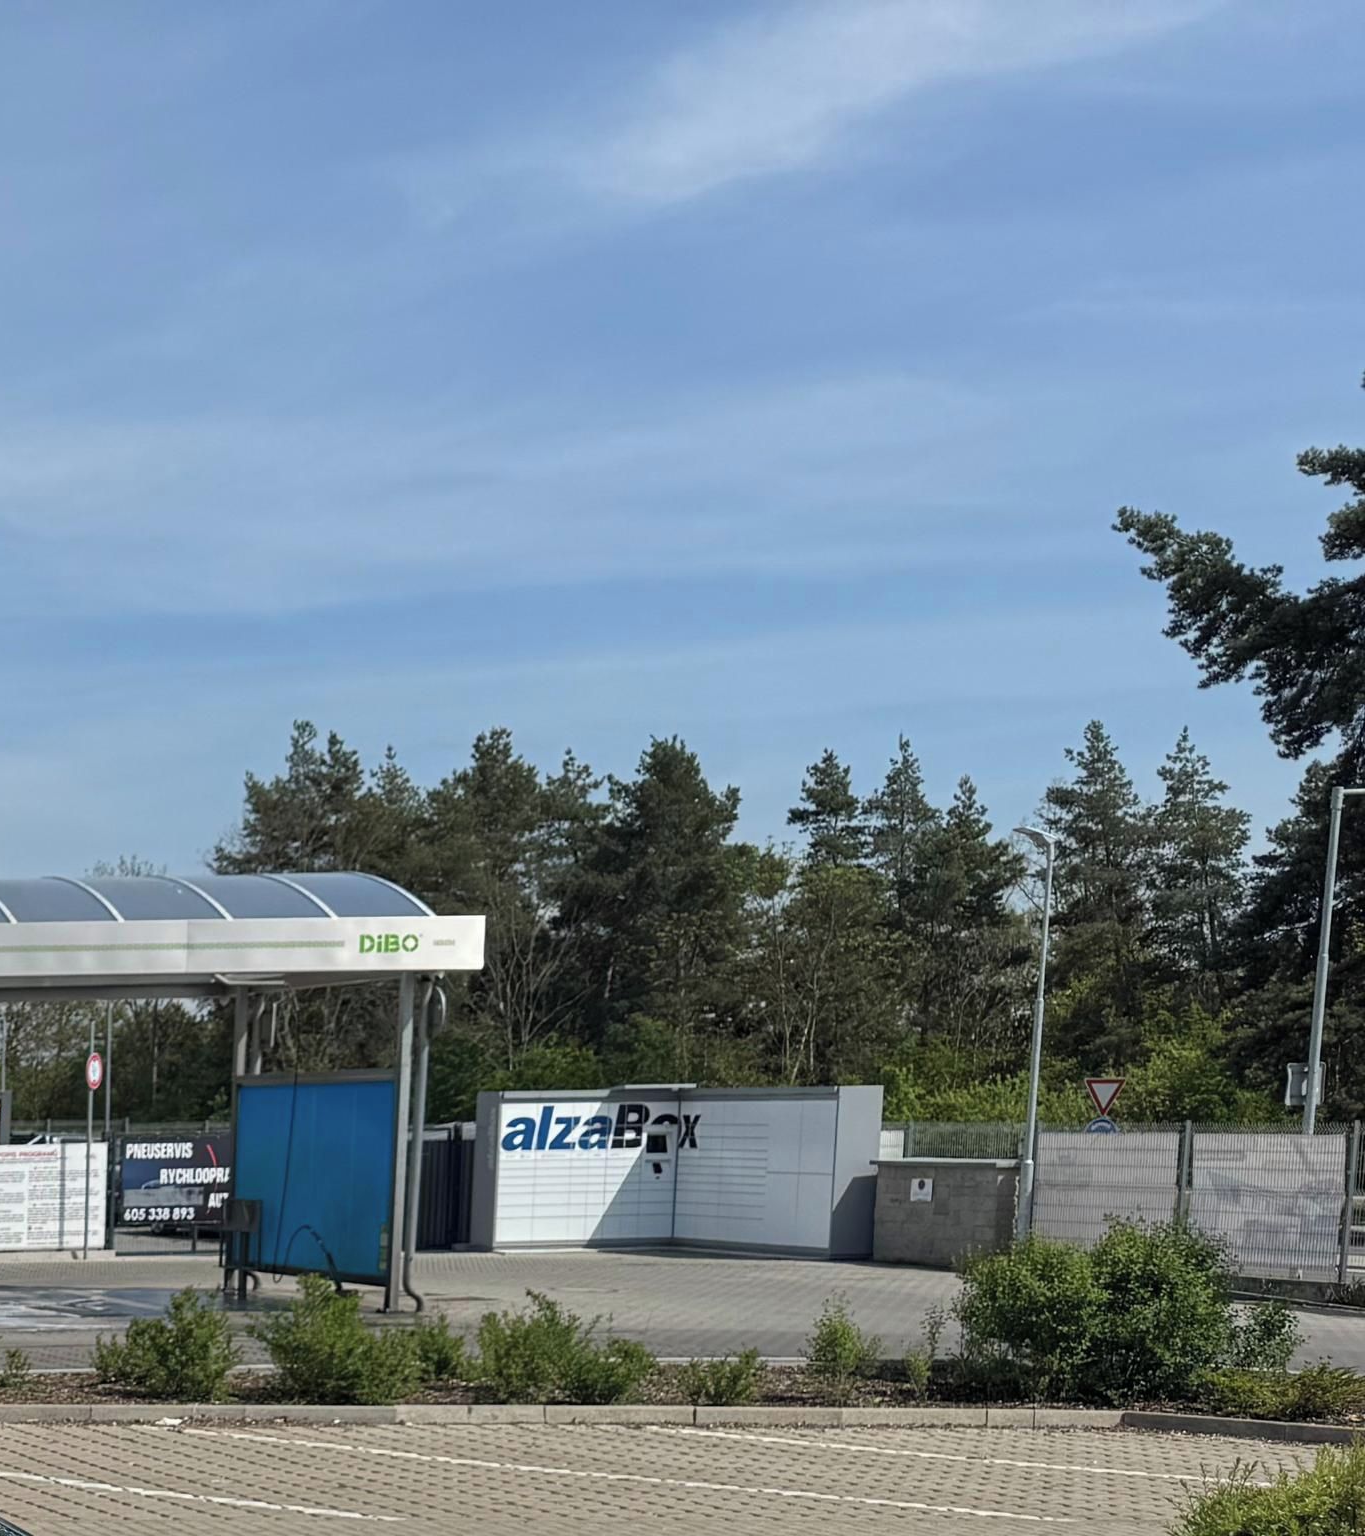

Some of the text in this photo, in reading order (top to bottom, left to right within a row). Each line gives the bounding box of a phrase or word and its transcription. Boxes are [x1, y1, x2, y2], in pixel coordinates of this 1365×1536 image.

[126, 1142, 194, 1159] PNEUSERVIS
[123, 1207, 195, 1221] 605 338 893
